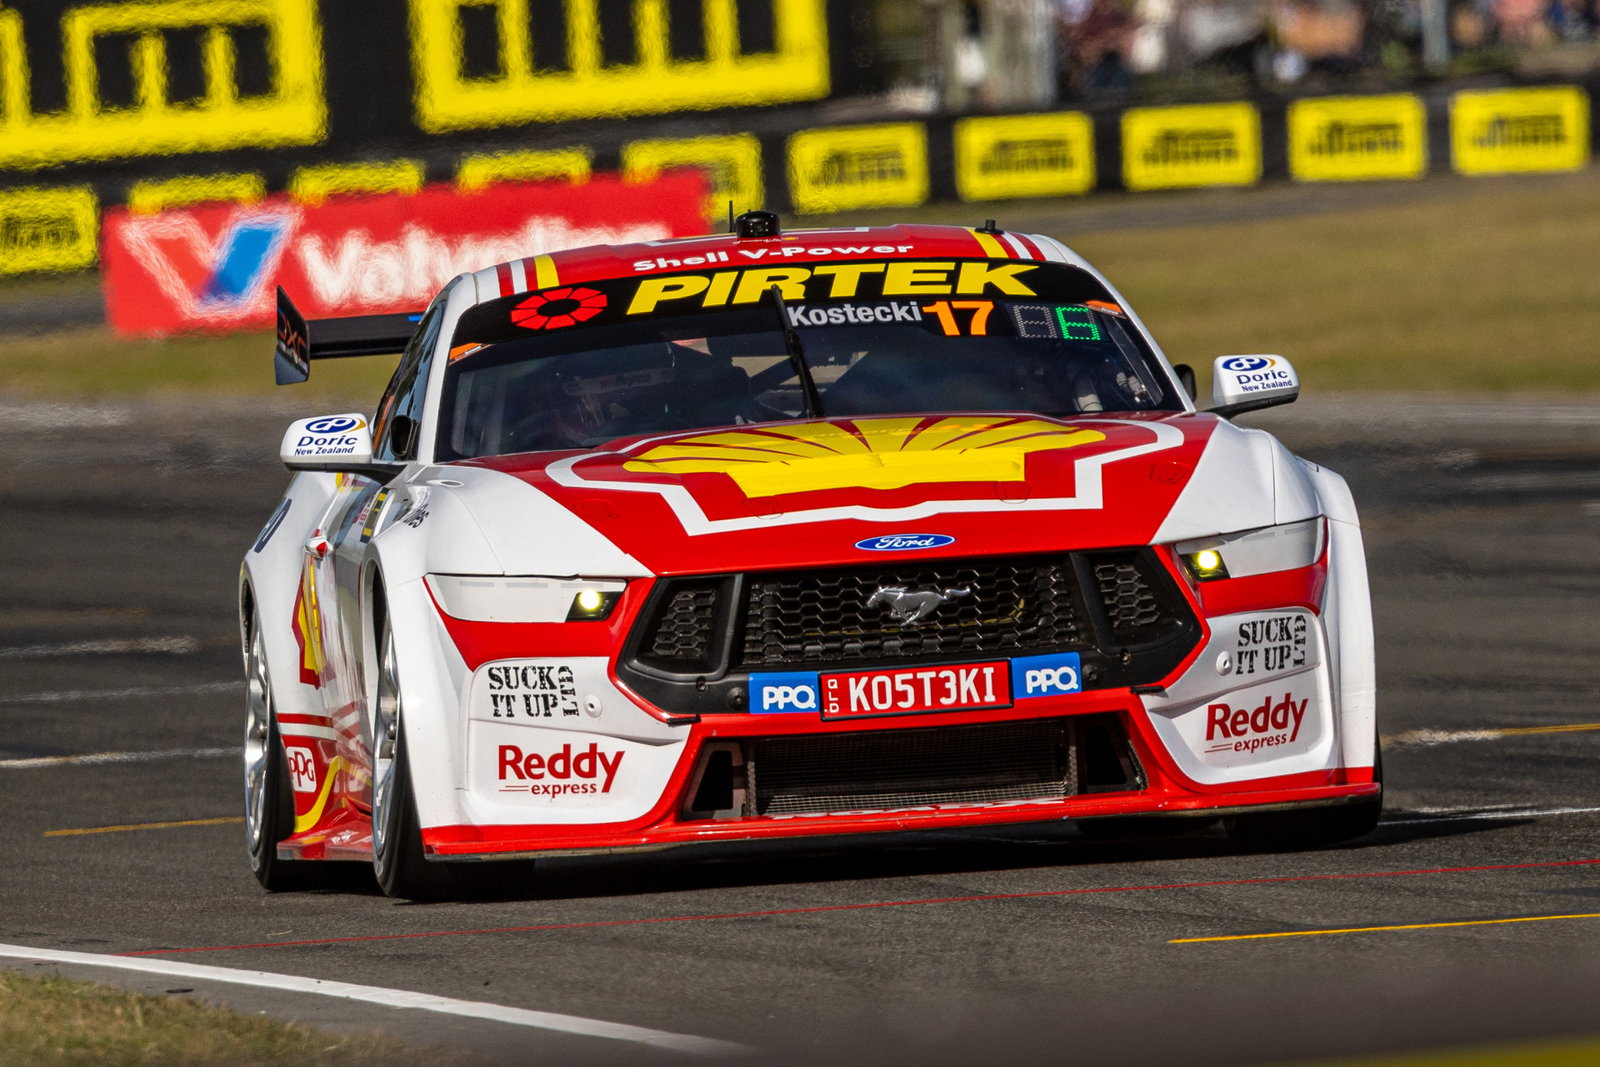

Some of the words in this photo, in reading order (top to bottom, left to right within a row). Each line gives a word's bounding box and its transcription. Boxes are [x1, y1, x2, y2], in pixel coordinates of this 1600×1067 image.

[633, 251, 729, 272] Shell
[739, 240, 914, 259] V-Power
[625, 261, 1040, 316] PIRTEK
[788, 302, 922, 328] Kostecki
[922, 301, 995, 336] 17
[1236, 370, 1288, 385] Doric
[1261, 379, 1293, 390] Zealand
[294, 447, 313, 456] New
[315, 445, 354, 455] Zealand
[297, 435, 358, 447] Doric
[875, 535, 935, 549] Ford
[1238, 616, 1292, 647] SUCK
[1293, 615, 1307, 667] LTD
[1264, 644, 1292, 671] UP
[488, 665, 557, 690] SUCK
[1025, 665, 1079, 694] PPQ
[558, 666, 580, 717] LTD
[762, 684, 817, 710] PPQ
[523, 694, 558, 717] UP
[1206, 692, 1309, 742] Reddy
[1234, 733, 1287, 753] express
[498, 743, 626, 793] Reddy
[531, 783, 597, 798] express
